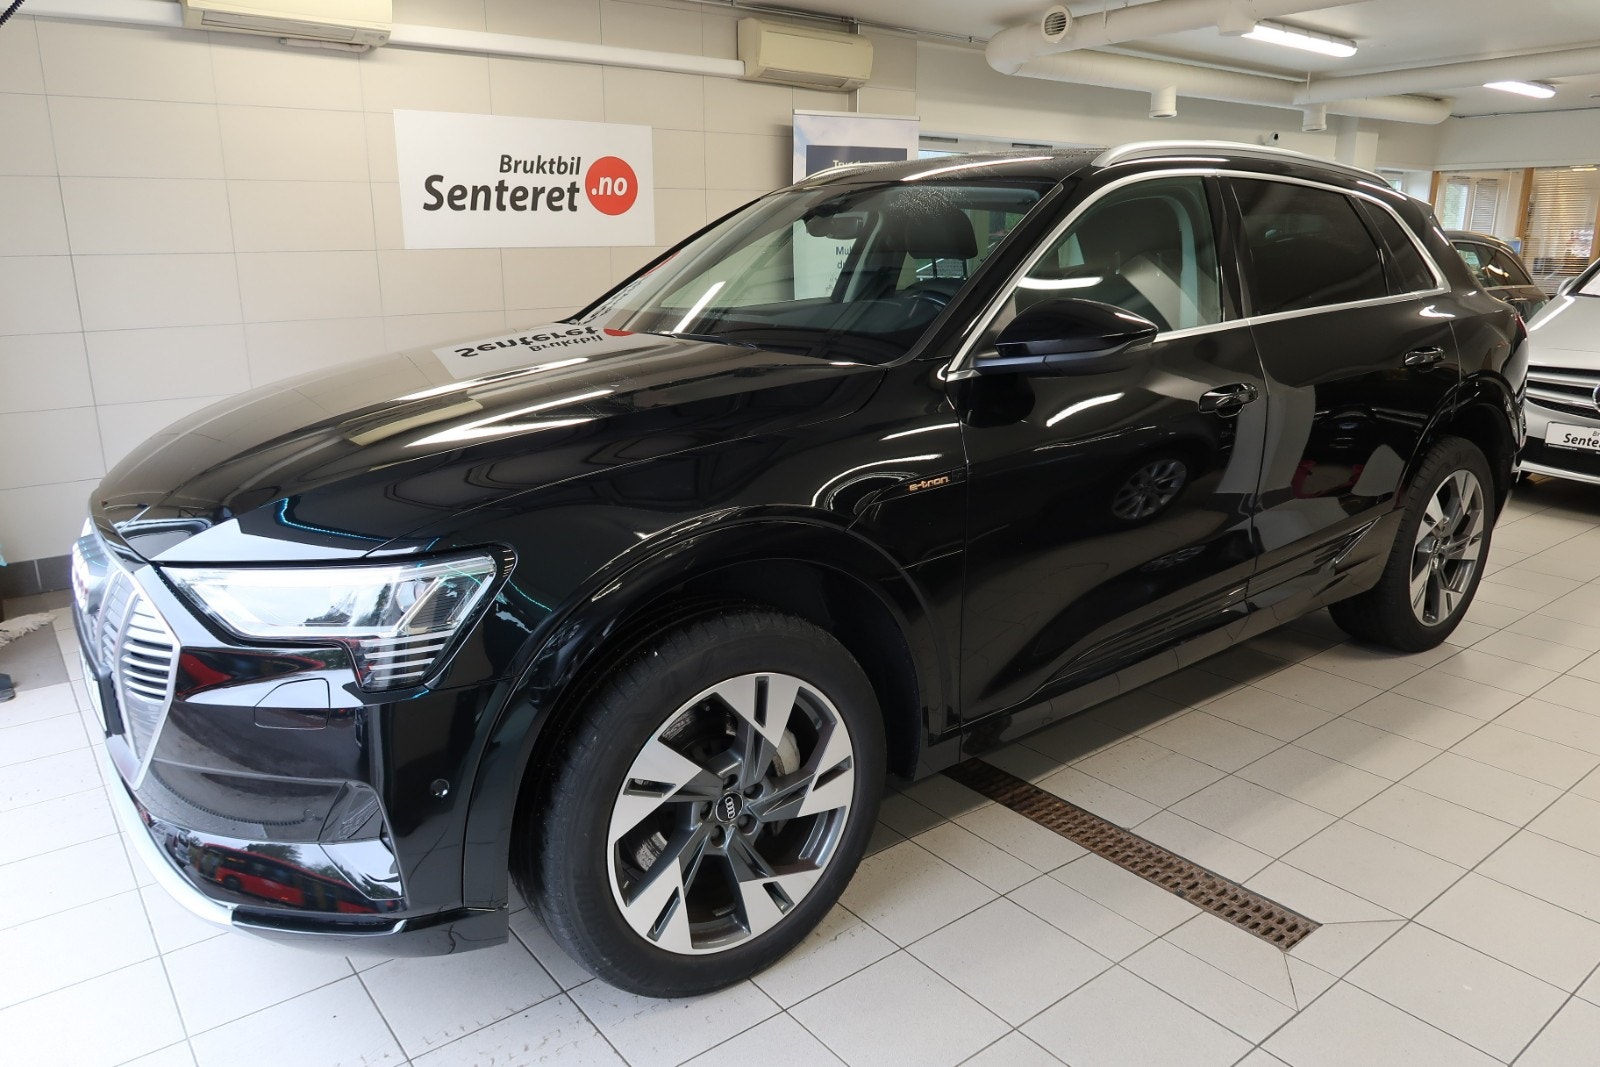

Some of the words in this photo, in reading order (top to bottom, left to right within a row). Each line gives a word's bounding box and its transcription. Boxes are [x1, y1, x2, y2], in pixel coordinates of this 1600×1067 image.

[499, 154, 582, 176] Bruktbil
[422, 174, 580, 212] Senteret
[591, 175, 628, 196] .no
[1563, 433, 1600, 448] Sente
[909, 476, 949, 491] e-tron
